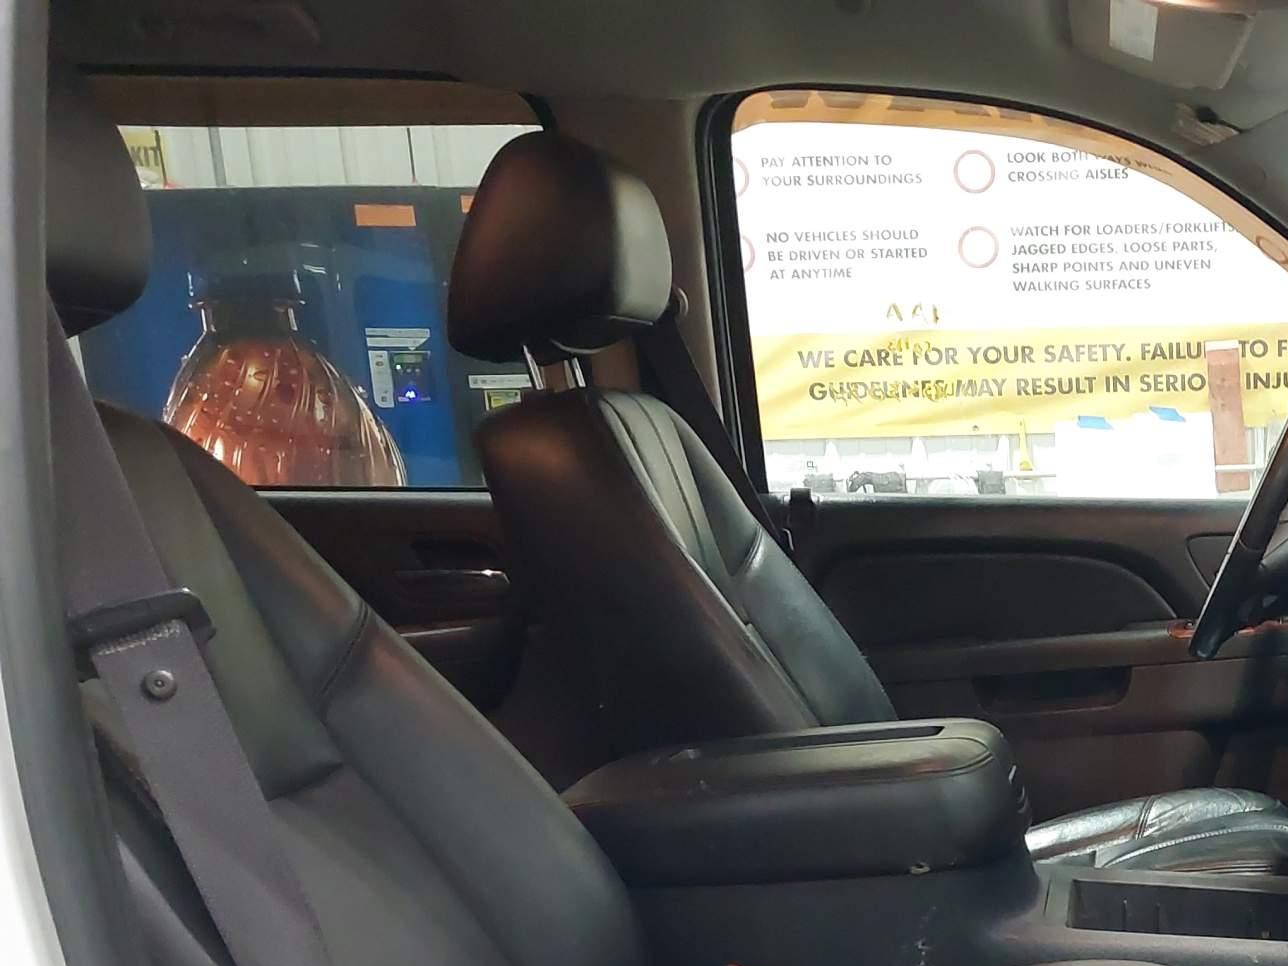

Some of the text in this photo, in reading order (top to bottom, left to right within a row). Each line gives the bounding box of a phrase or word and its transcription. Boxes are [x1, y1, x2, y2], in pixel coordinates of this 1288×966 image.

[761, 154, 892, 168] PAY ATTENTION TO
[1007, 151, 1046, 163] LOOK
[762, 173, 923, 187] YOUR SURROUNDINGS
[1008, 168, 1080, 182] CROSSING
[1085, 167, 1129, 180] AISLES
[766, 229, 918, 243] NO VEHICLES SHOULD
[1010, 225, 1059, 236] WATCH
[1064, 224, 1091, 235] FOR
[768, 247, 927, 262] BE DRIVEN OR STARTED
[1011, 243, 1066, 255] JAGGED
[1124, 241, 1168, 253] LOOSE
[1173, 240, 1218, 253] PARTS,
[770, 267, 853, 280] AT ANYTIME
[1012, 259, 1211, 274] SHARP POINTS AND UNEVEN
[1013, 278, 1152, 292] WALKING SURFACES
[797, 350, 836, 369] WE
[843, 349, 904, 368] CARE
[912, 347, 960, 366] FOR
[967, 345, 1036, 365] YOUR
[1044, 342, 1132, 363] SAFETY.
[1140, 340, 1207, 362] FAILU
[1238, 339, 1268, 358] TO
[808, 379, 945, 400] GUIDELINES
[955, 378, 1007, 397] MAY
[1016, 376, 1096, 396] RESULT
[1105, 375, 1130, 393] IN
[1139, 373, 1206, 392] SERIO
